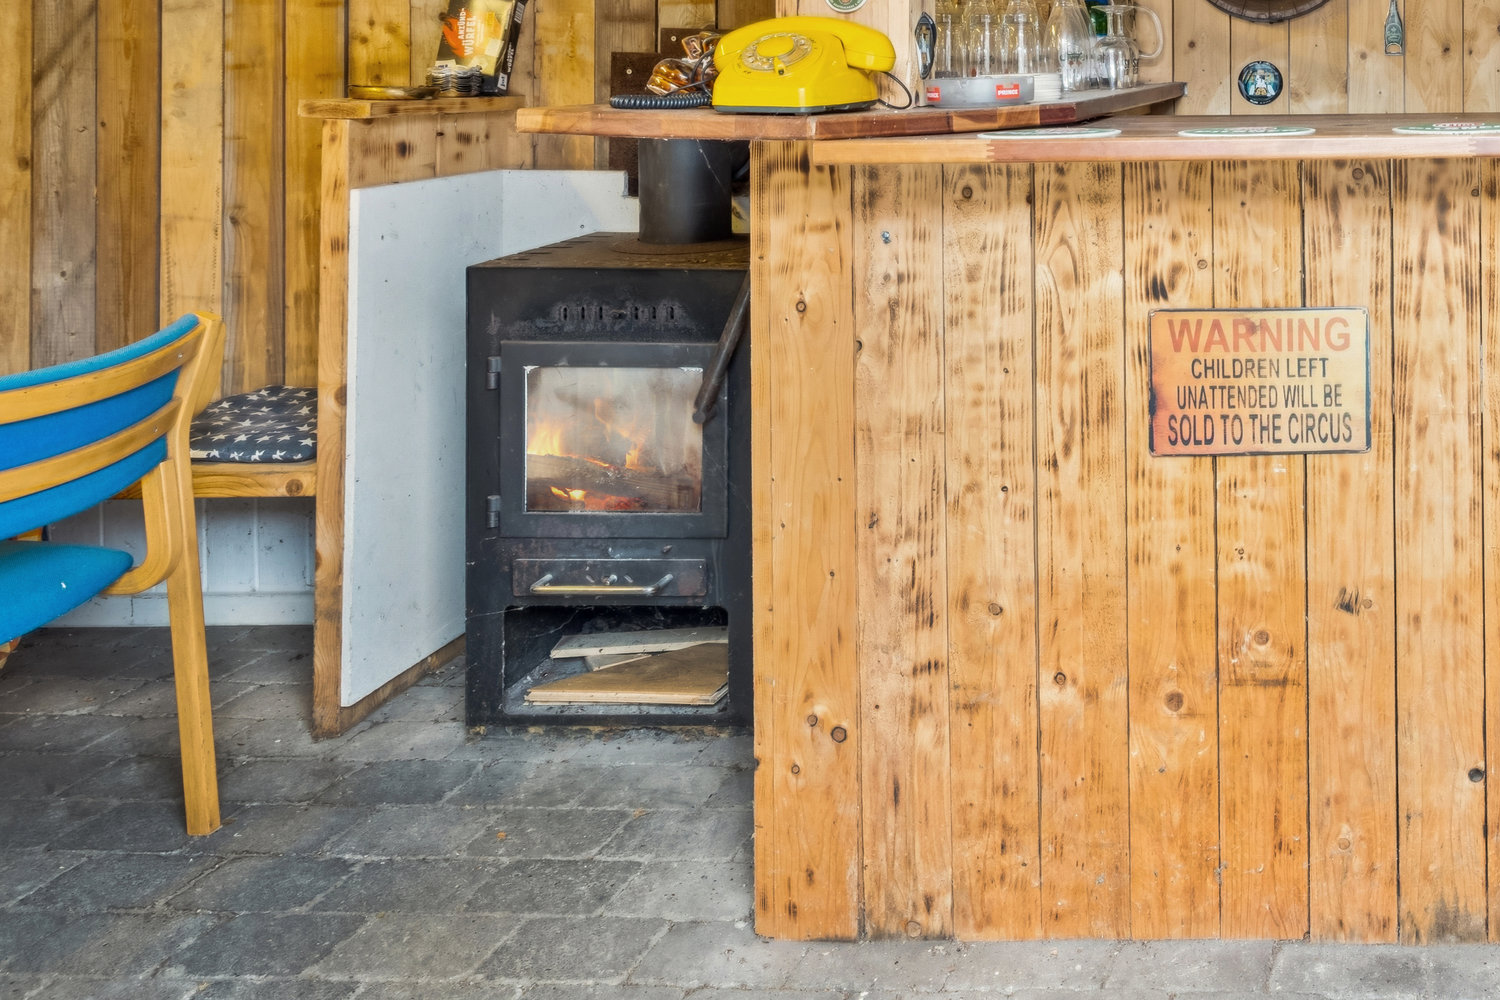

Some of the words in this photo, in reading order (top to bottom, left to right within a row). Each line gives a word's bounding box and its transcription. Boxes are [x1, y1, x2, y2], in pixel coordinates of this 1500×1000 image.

[462, 15, 477, 56] WÜRFEL
[1167, 316, 1351, 353] WARNING
[1191, 357, 1280, 379] CHILDREN
[1286, 357, 1329, 378] LEFT
[1177, 384, 1278, 410] UNATTENDED
[1282, 384, 1319, 408] WILL
[1322, 383, 1343, 407] BE
[1168, 413, 1215, 446] SOLD
[1220, 414, 1244, 445] TO
[1249, 413, 1282, 444] THE
[1288, 412, 1352, 444] CIRCUS
